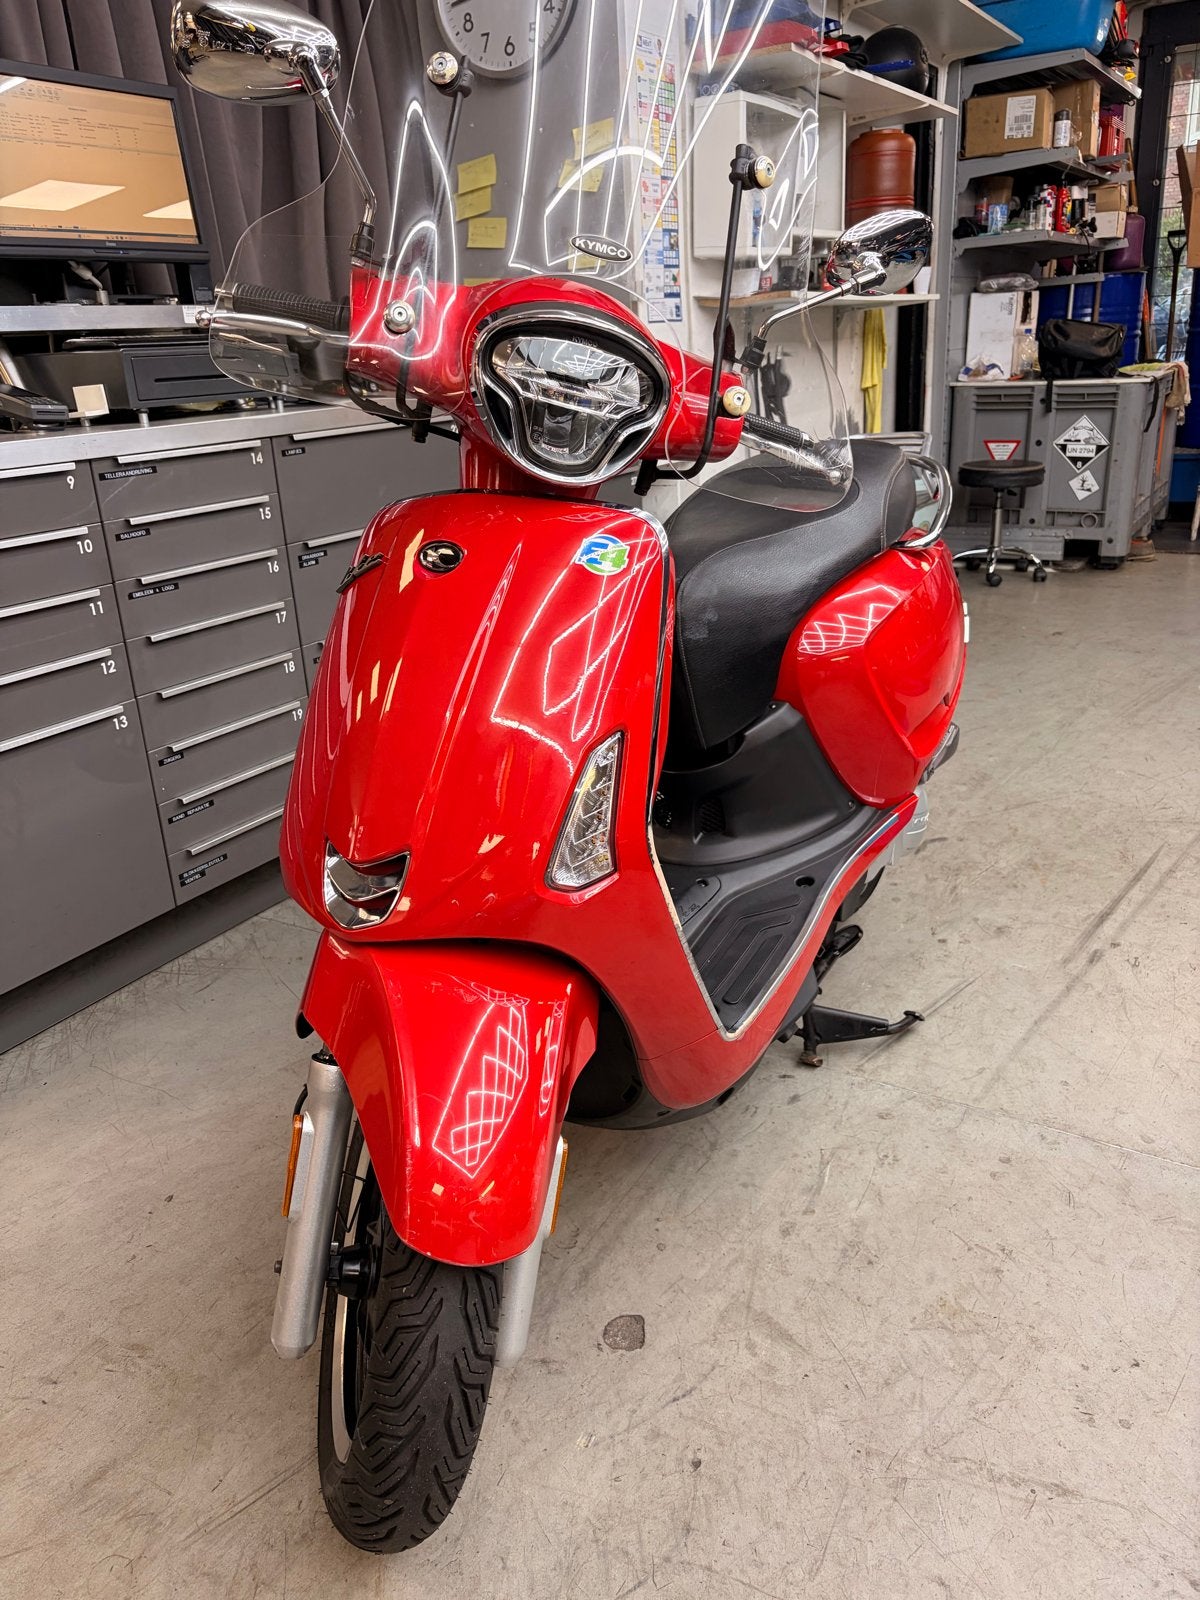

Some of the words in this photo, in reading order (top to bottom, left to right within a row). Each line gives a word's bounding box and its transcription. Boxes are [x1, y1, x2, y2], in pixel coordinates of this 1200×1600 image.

[543, 0, 556, 13] 4
[463, 12, 474, 33] 8
[480, 31, 490, 53] 7
[504, 35, 515, 56] 6
[575, 237, 628, 259] KYMCO
[250, 452, 264, 465] 14
[1076, 461, 1082, 469] 8
[66, 475, 75, 489] 9
[259, 507, 272, 520] 15
[76, 538, 93, 554] 10
[267, 561, 280, 574] 16
[89, 601, 104, 616] 11
[275, 611, 287, 624] 17
[101, 660, 117, 675] 12
[284, 660, 296, 674] 18
[292, 708, 303, 721] 19
[112, 715, 127, 731] 13
